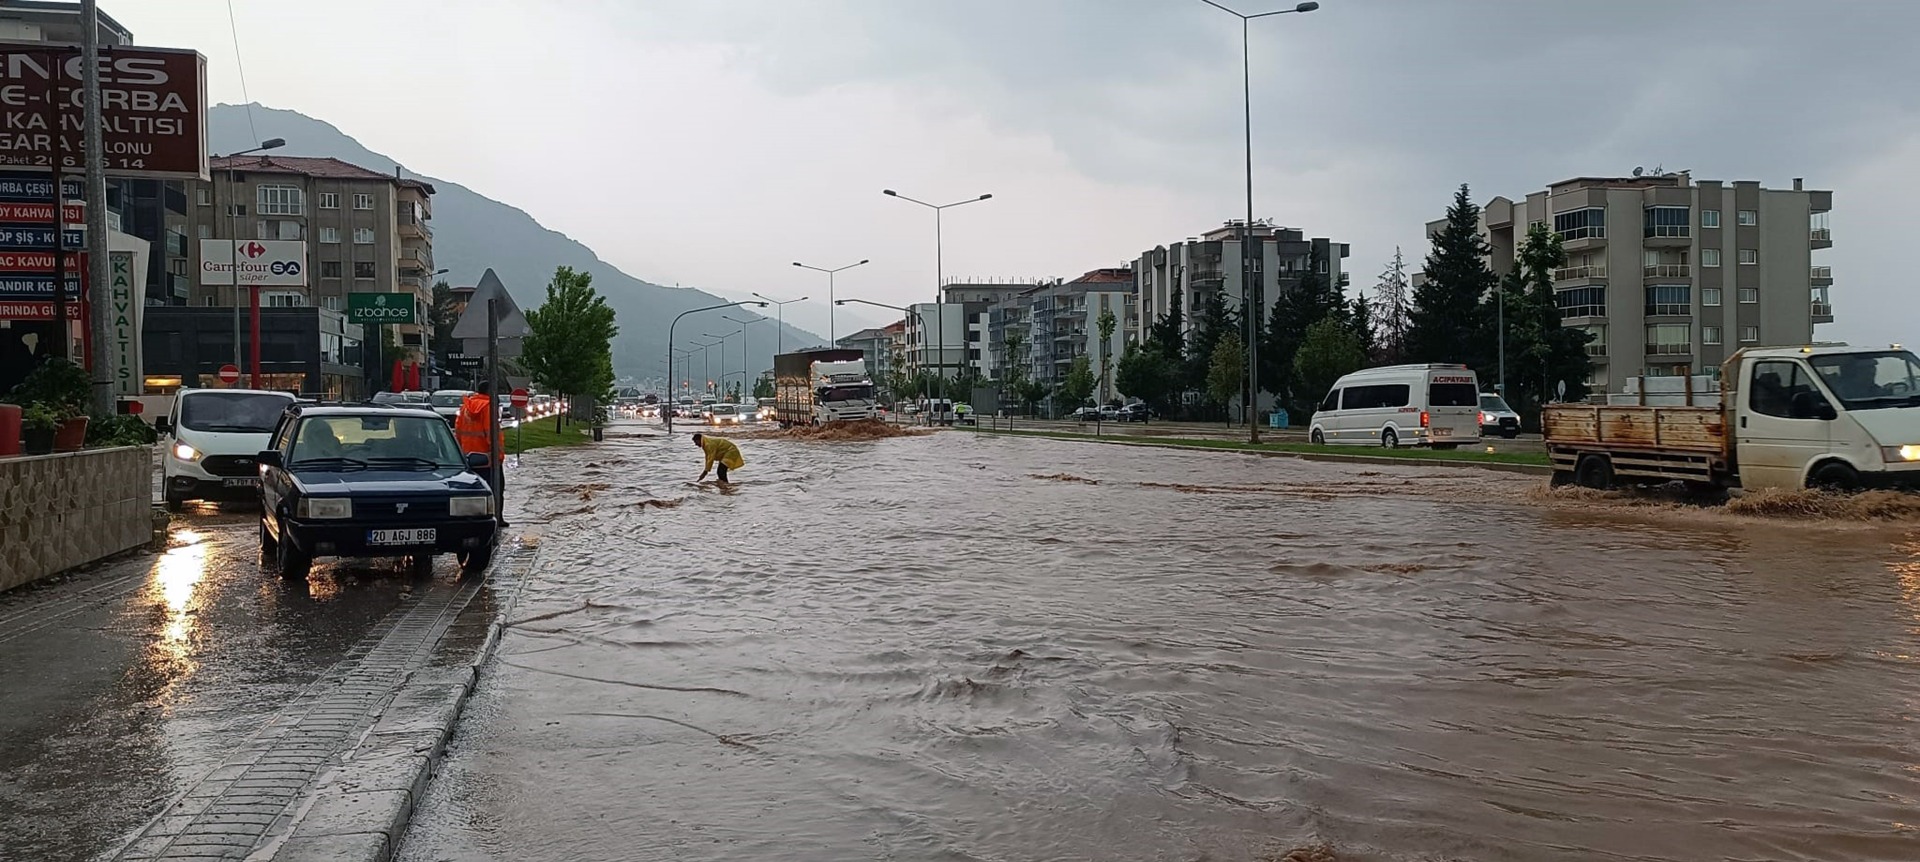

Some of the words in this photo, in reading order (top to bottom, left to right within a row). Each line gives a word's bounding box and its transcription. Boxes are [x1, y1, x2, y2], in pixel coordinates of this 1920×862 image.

[0, 53, 169, 85] NES
[79, 141, 152, 156] SLONU
[120, 158, 146, 169] 14
[26, 181, 79, 197] ÇEŞİTERİ
[203, 260, 267, 273] Carrefour
[240, 273, 268, 283] süper
[42, 304, 79, 319] GÜEÇ
[113, 262, 130, 392] KAHVALTISI
[373, 531, 386, 542] 20
[392, 530, 411, 541] AGJ
[416, 530, 435, 541] 886
